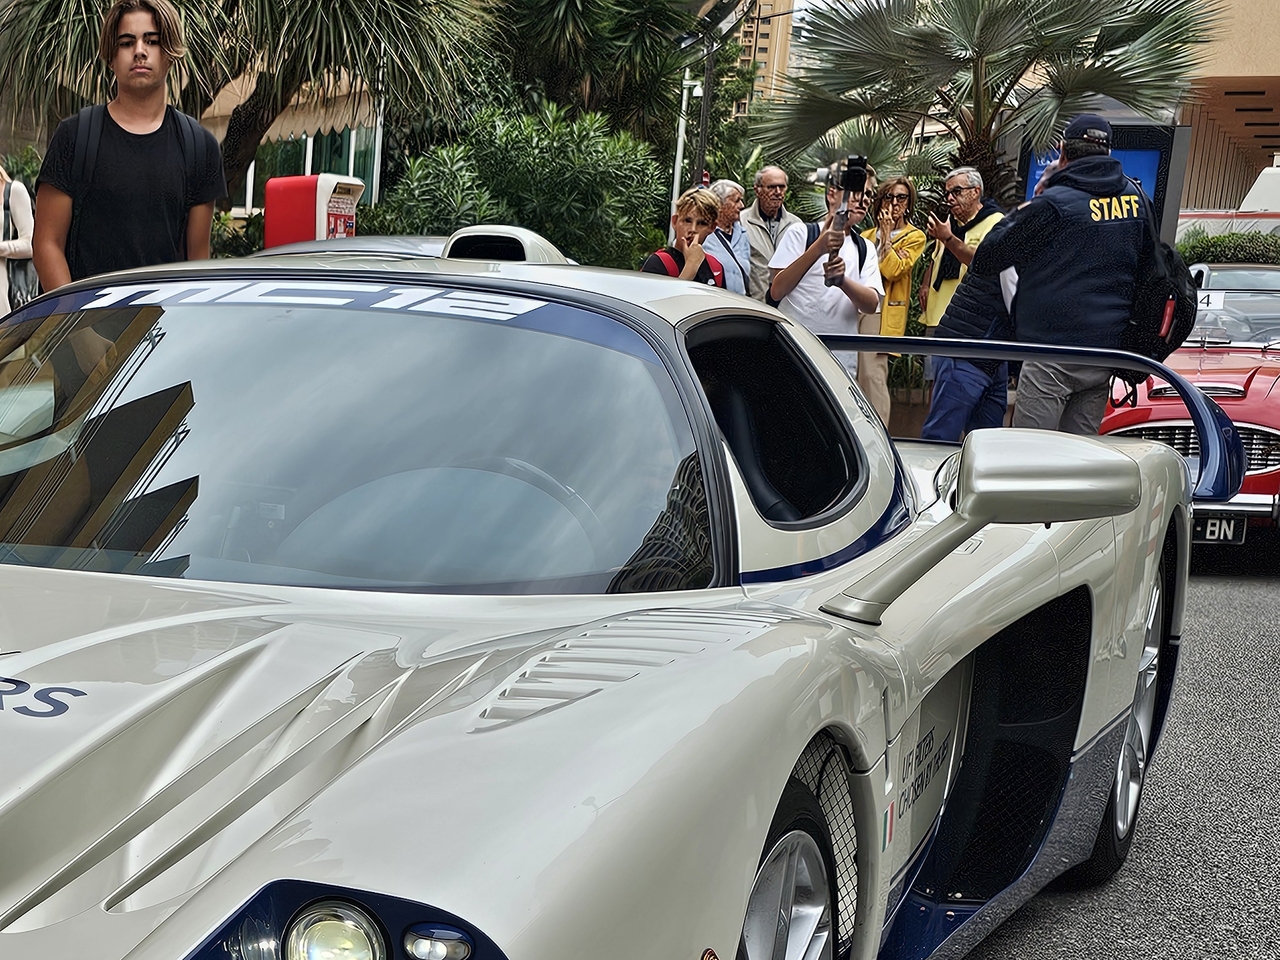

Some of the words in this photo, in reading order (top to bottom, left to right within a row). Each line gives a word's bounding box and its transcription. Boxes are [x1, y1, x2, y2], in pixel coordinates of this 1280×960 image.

[1089, 195, 1139, 221] STAFF
[81, 281, 549, 321] MC12
[1199, 293, 1212, 307] 4
